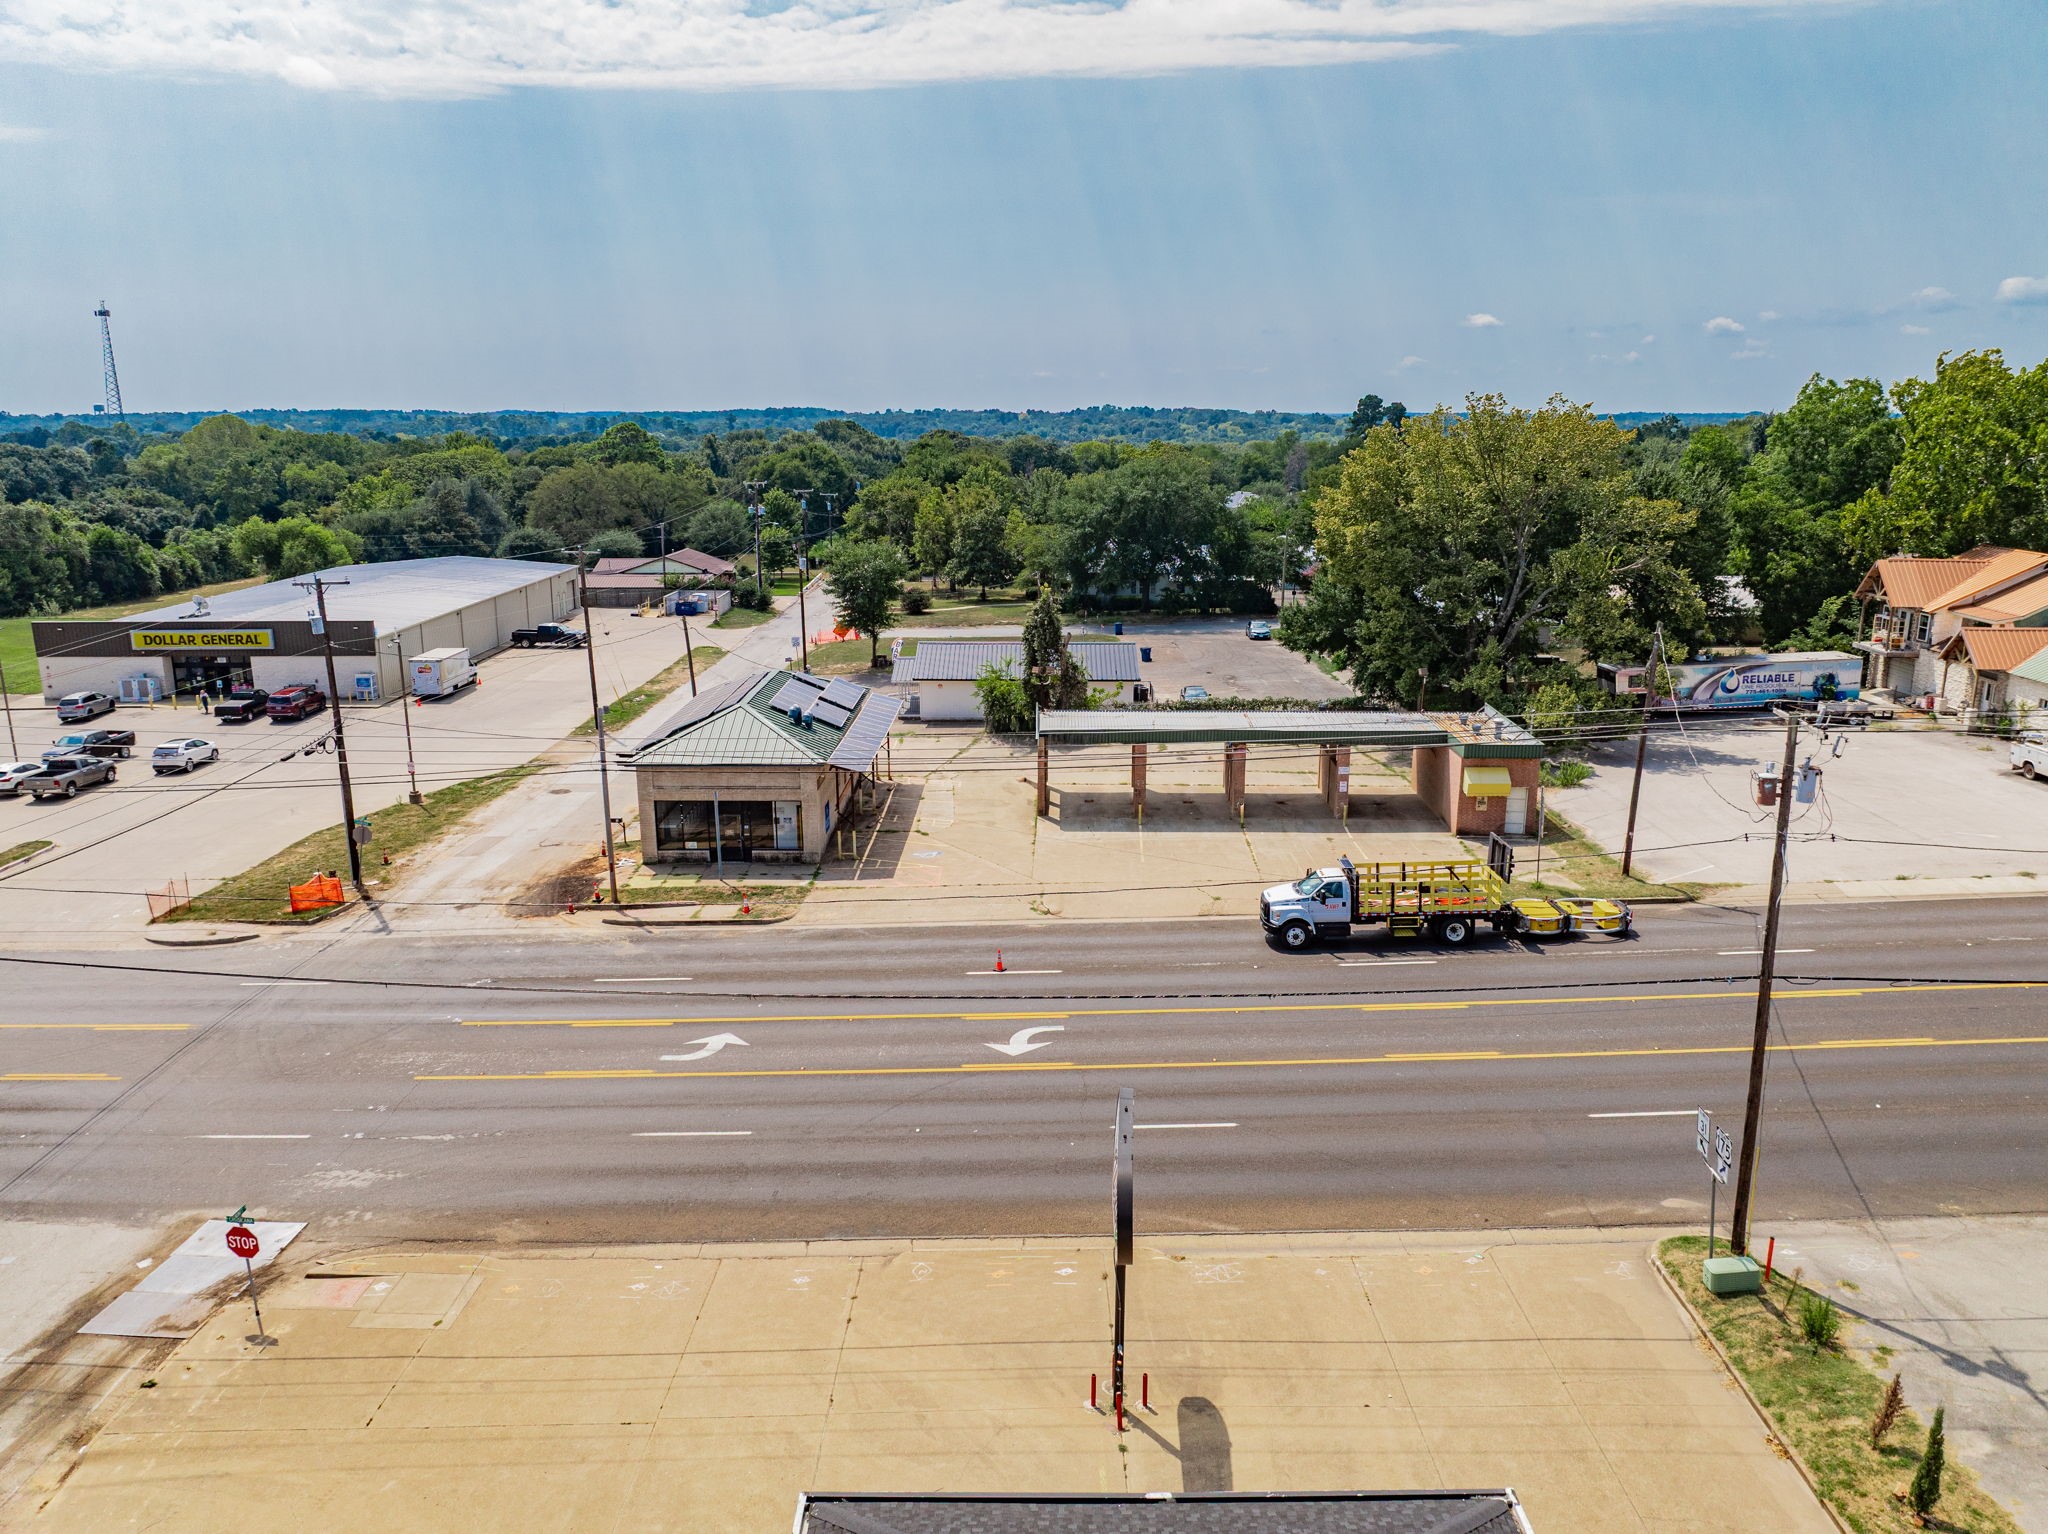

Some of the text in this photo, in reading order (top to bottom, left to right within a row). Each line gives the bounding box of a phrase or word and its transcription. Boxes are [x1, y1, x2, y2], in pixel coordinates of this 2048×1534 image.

[143, 634, 262, 645] DOLLAR GENERAL
[1742, 674, 1795, 684] RELIABLE
[1700, 1120, 1707, 1135] 31
[1717, 1134, 1731, 1160] 175
[228, 1235, 257, 1250] STOP
